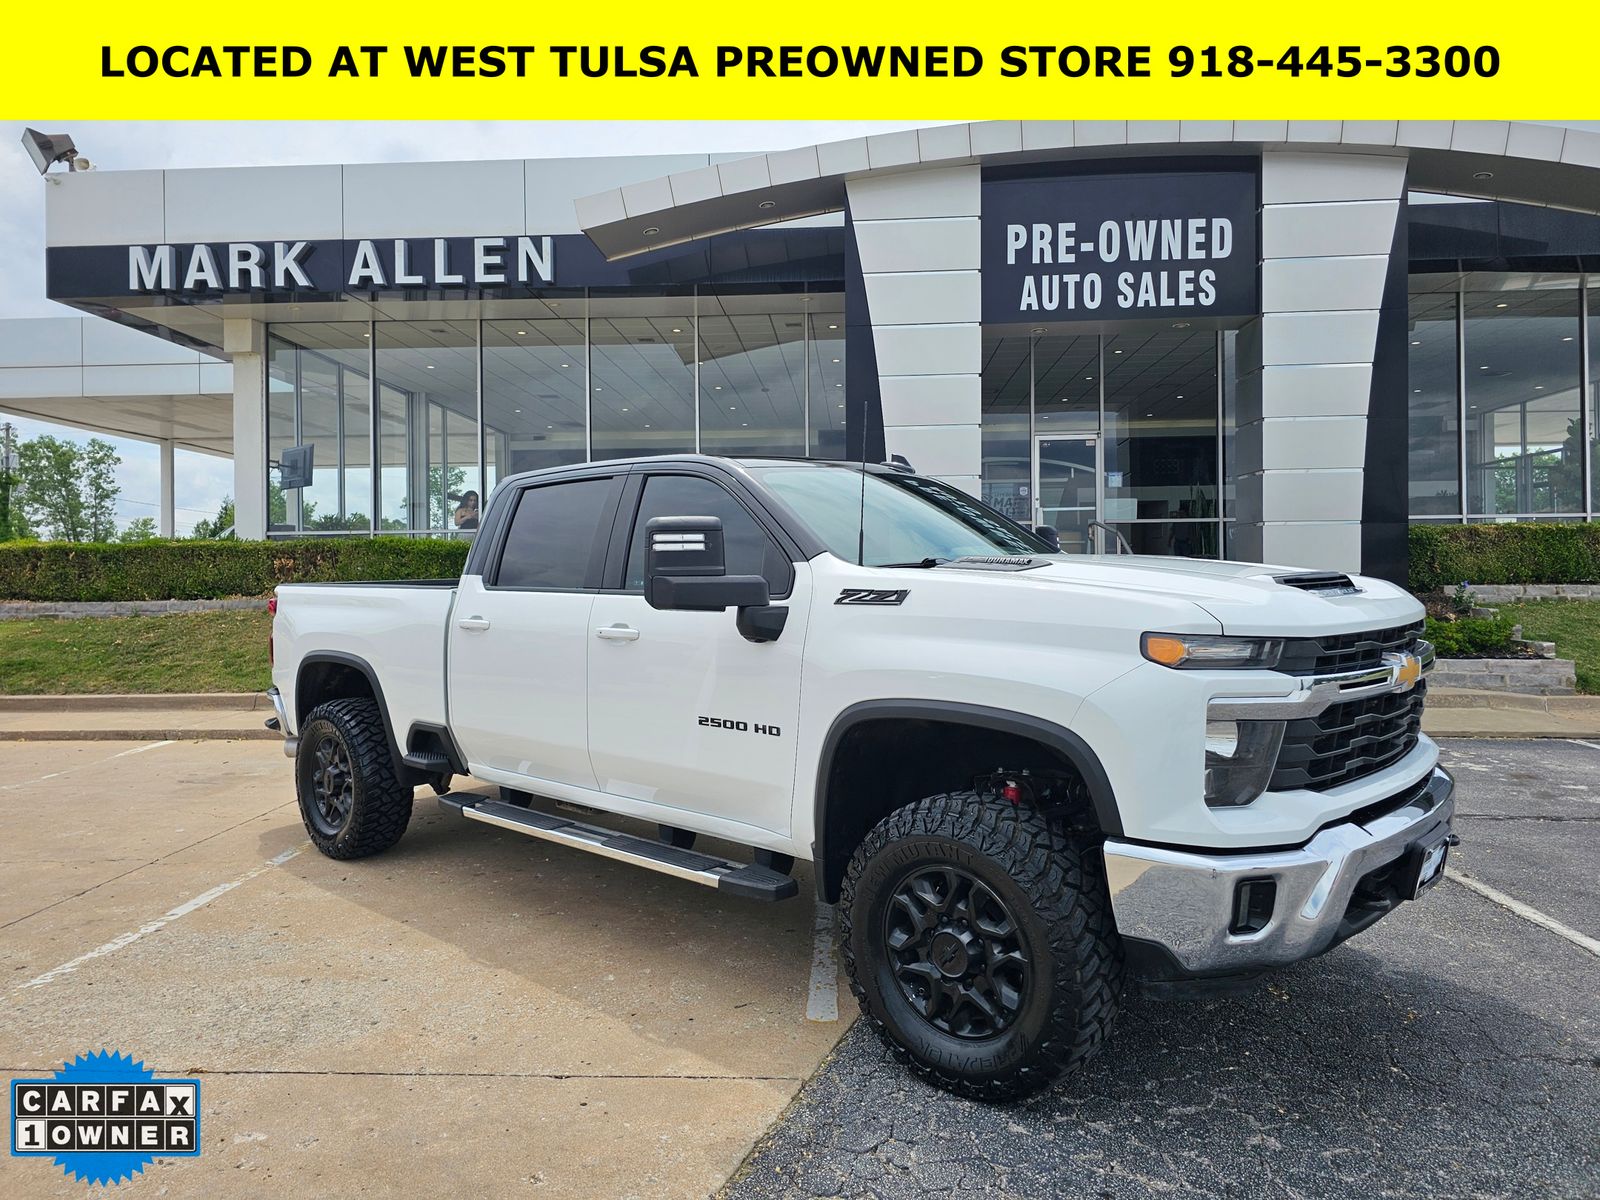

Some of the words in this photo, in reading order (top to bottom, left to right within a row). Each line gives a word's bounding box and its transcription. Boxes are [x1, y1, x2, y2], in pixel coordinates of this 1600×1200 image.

[1007, 217, 1233, 264] PRE-OWNED
[129, 242, 312, 291] MARK
[348, 236, 555, 287] ALLEN
[1020, 272, 1101, 311] AUTO
[1118, 269, 1216, 308] SALES
[834, 589, 910, 606] Z71
[698, 716, 748, 732] 2500
[754, 723, 781, 737] HD
